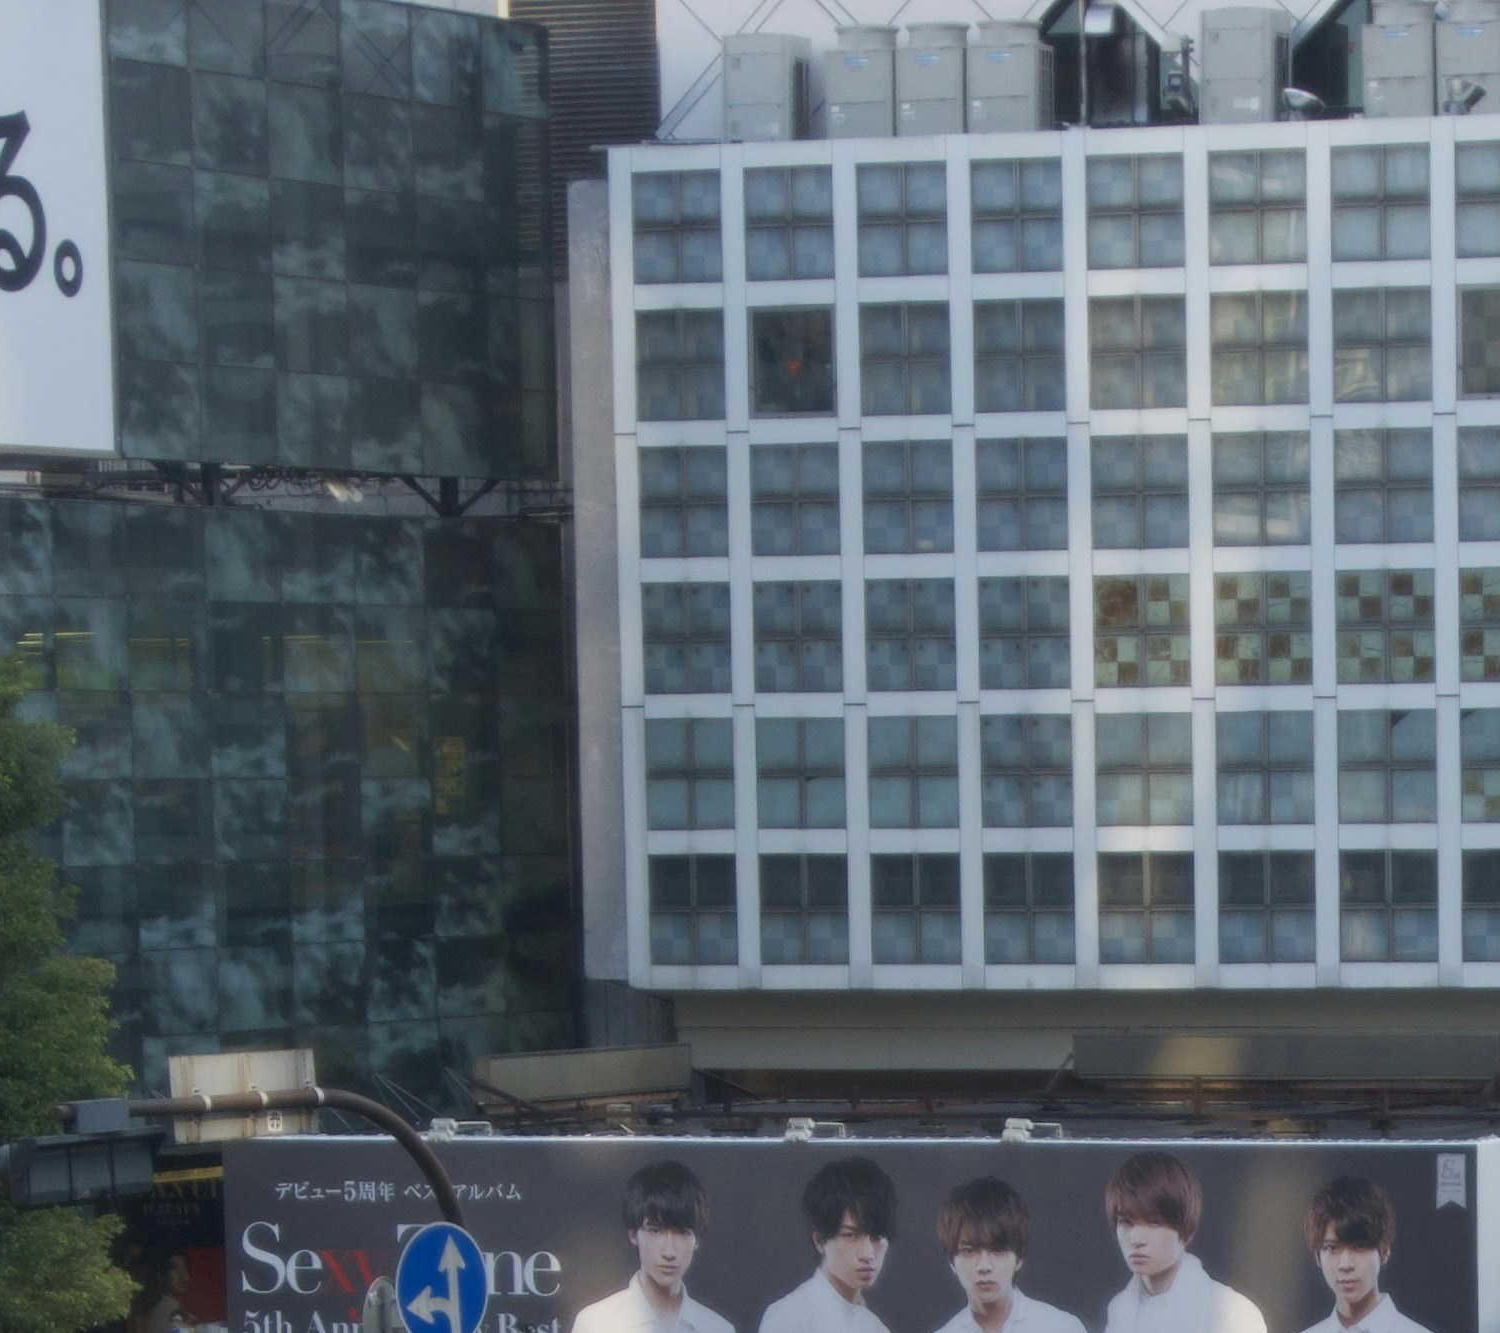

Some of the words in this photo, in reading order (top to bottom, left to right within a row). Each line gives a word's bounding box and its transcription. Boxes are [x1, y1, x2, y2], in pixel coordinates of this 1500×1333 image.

[275, 1180, 396, 1203] デビュー5周年
[402, 1182, 522, 1200] ベスアルバム
